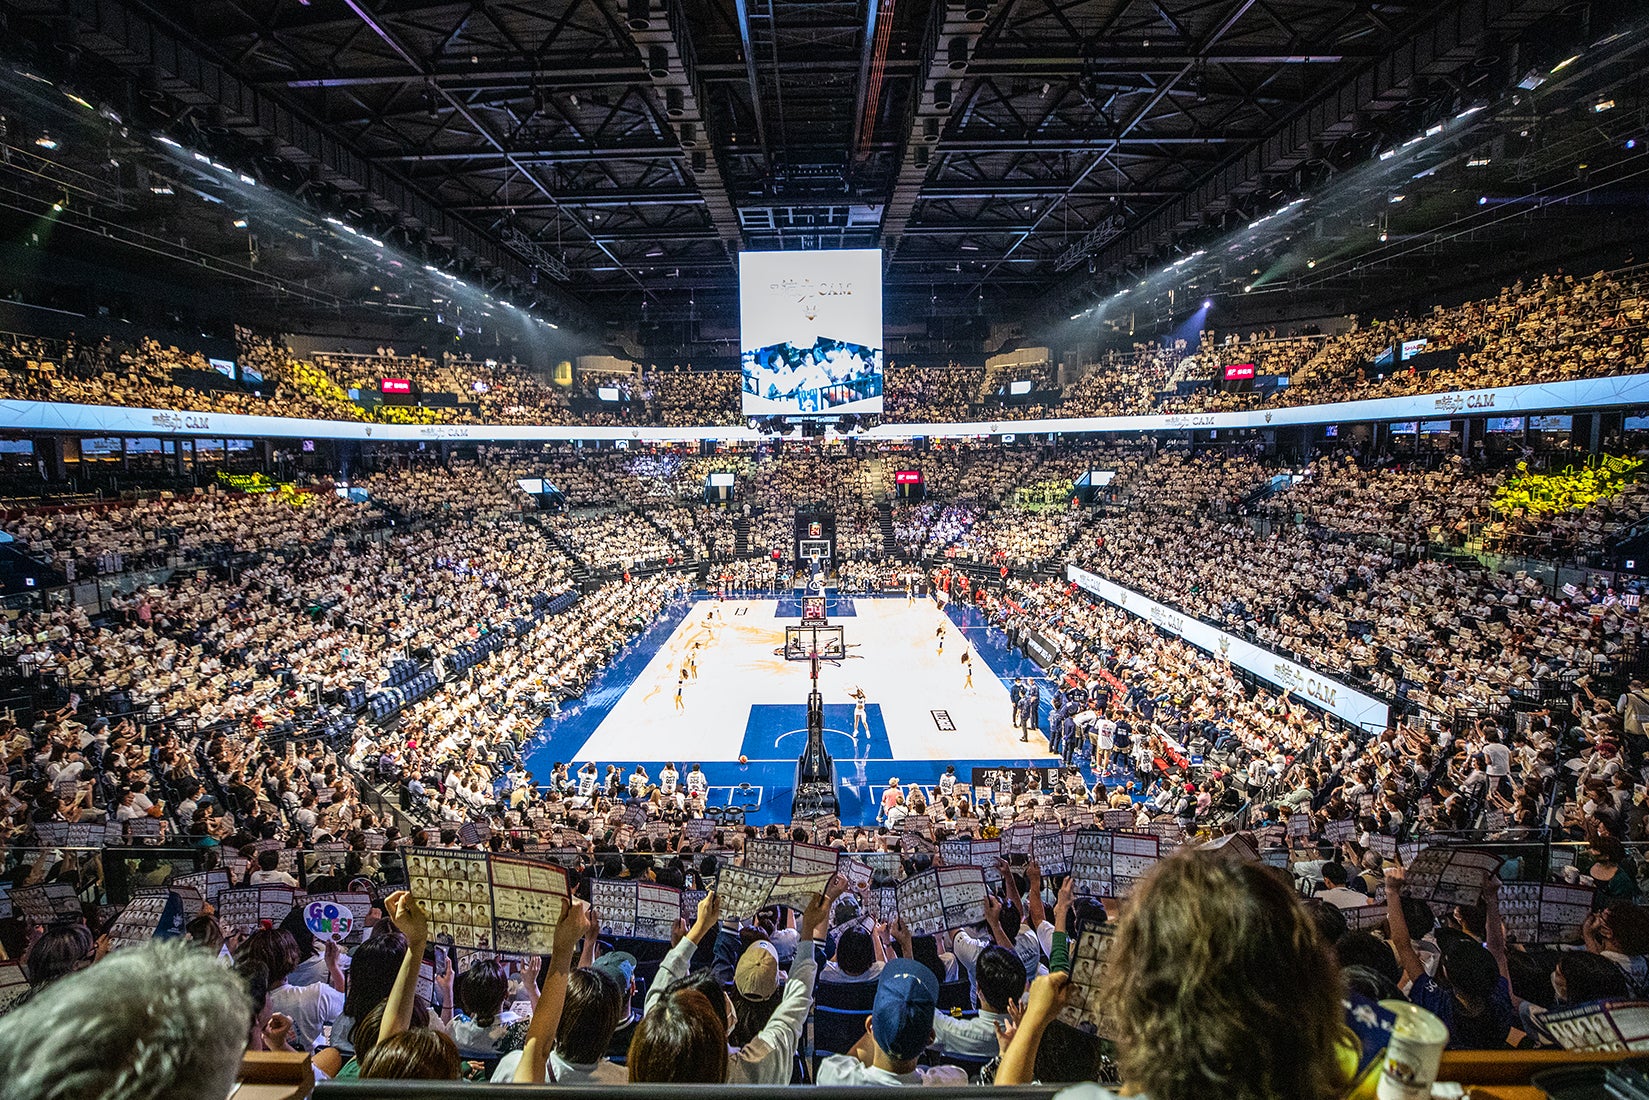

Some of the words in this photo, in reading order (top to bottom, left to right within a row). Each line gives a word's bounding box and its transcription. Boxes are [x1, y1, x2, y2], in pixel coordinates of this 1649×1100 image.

[1466, 393, 1496, 409] CAM
[185, 416, 209, 430] CAM
[806, 606, 822, 618] 24
[1307, 678, 1337, 708] CAM
[309, 902, 339, 920] GO
[306, 917, 353, 933] KINGS!
